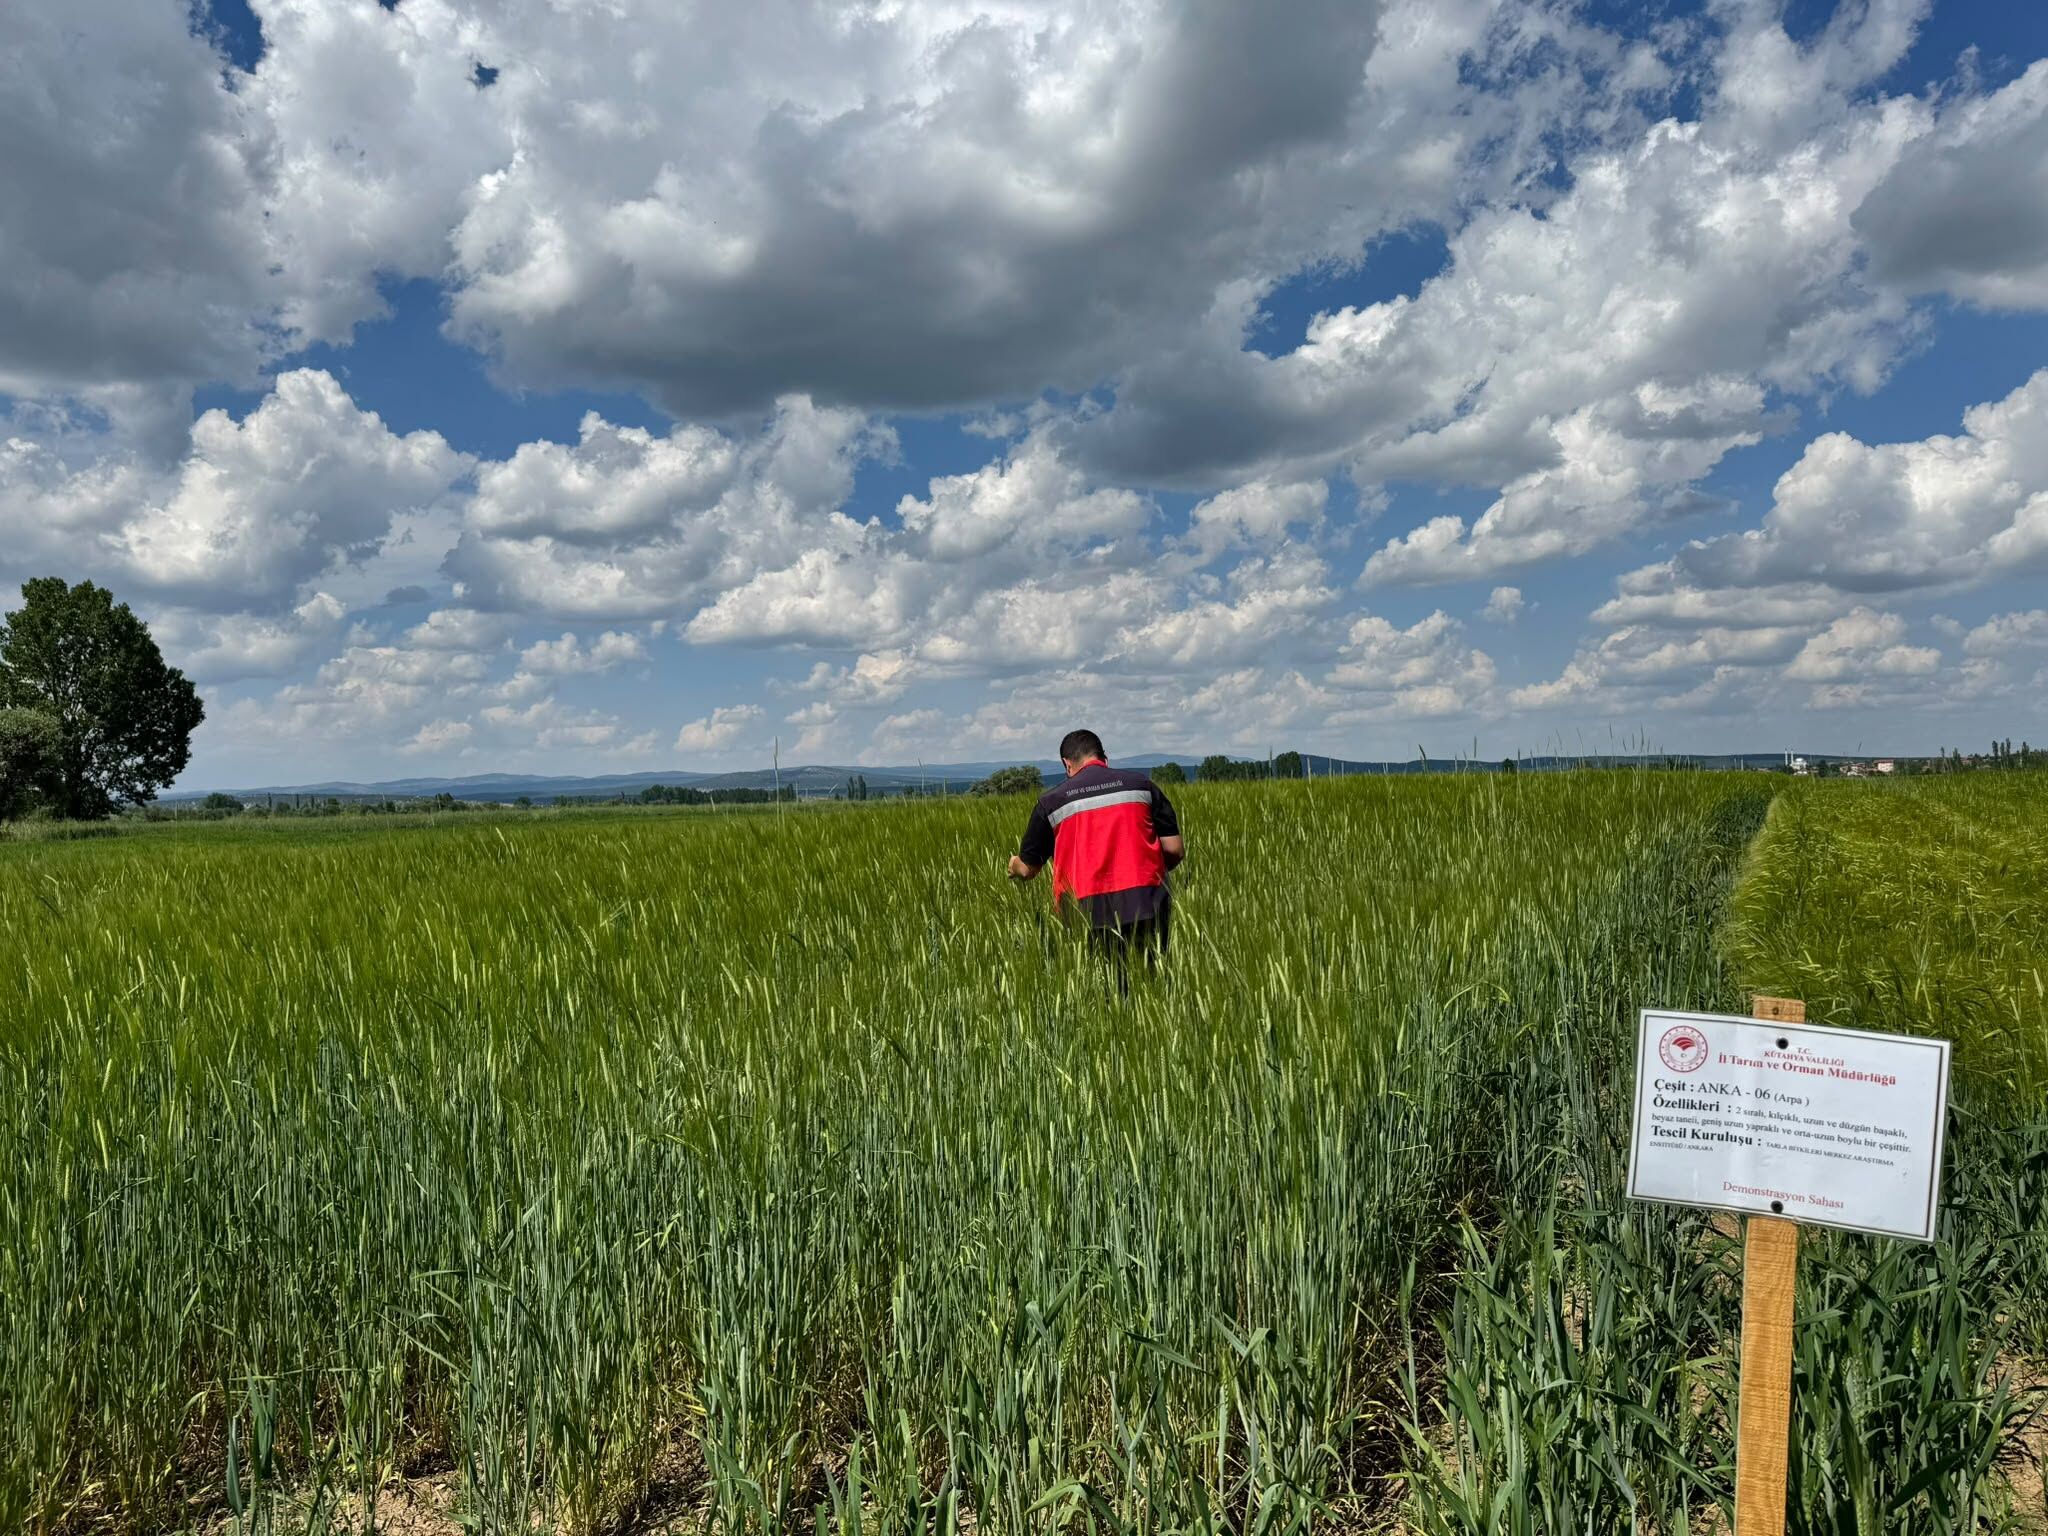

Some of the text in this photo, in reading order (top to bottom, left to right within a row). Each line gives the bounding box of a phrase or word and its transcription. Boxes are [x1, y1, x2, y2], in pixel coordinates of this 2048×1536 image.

[1718, 1052, 1896, 1086] İl Tarım ve Orman Müdürlüğü
[1764, 1050, 1804, 1062] KÜTAHYA
[1654, 1078, 1686, 1093] Çeşit
[1697, 1082, 1742, 1097] ANKA
[1754, 1087, 1771, 1100] 06
[1652, 1113, 1675, 1123] beyaz
[1701, 1117, 1722, 1127] geniş
[1724, 1120, 1744, 1129] uzun
[1745, 1122, 1779, 1134] yapraklı
[1781, 1127, 1792, 1135] ve
[1794, 1129, 1835, 1142] orta-uzun
[1837, 1134, 1862, 1146] boylu
[1864, 1138, 1878, 1148] bir
[1653, 1094, 1720, 1112] Özellikleri
[1735, 1106, 1742, 1115] 2
[1743, 1108, 1767, 1119] sıralı,
[1803, 1117, 1825, 1127] uzun
[1826, 1120, 1838, 1129] ve
[1839, 1120, 1871, 1133] düzgün
[1873, 1125, 1908, 1139] başaklı,
[1651, 1125, 1687, 1139] Tescil
[1691, 1128, 1753, 1146] Kuruluşu
[1722, 1181, 1844, 1209] Demonstrasyon Sahası
